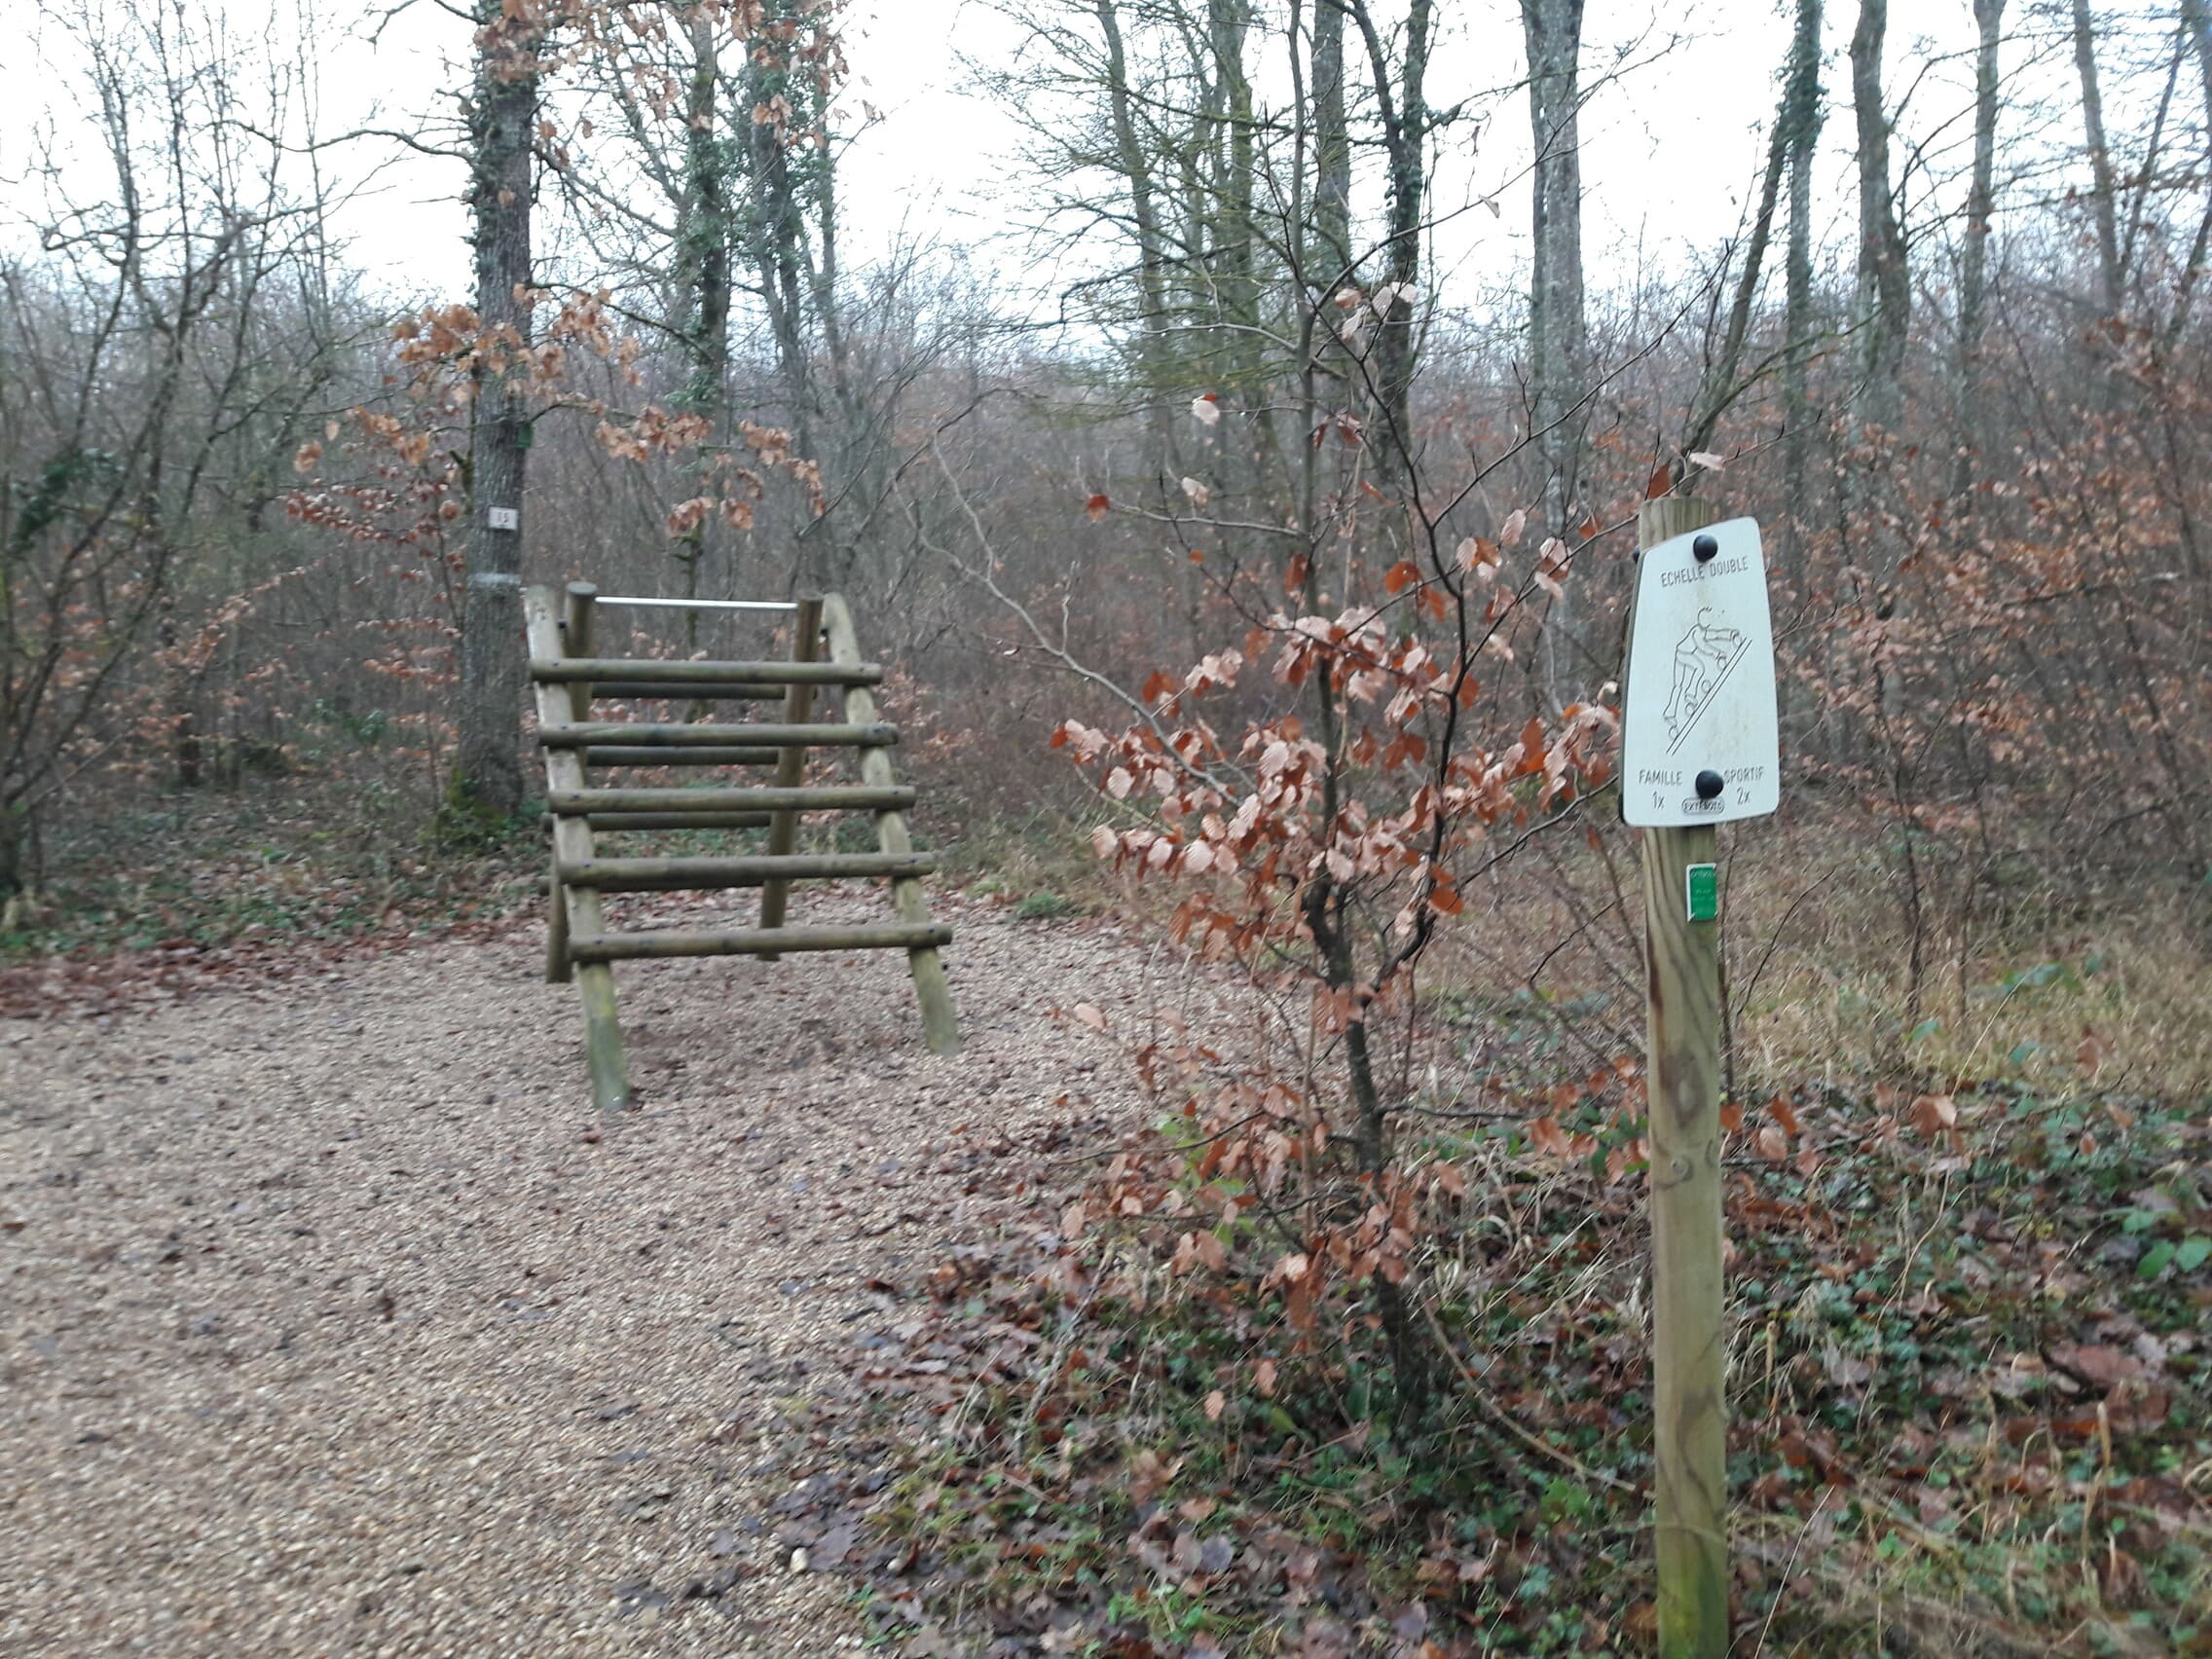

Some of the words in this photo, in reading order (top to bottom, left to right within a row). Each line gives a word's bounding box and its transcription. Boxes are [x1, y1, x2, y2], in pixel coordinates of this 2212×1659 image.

[1661, 564, 1705, 587] ECHELLE
[1710, 556, 1750, 576] DOUBLE
[1639, 769, 1683, 786] FAMILLE
[1723, 766, 1764, 785] SPORTIF
